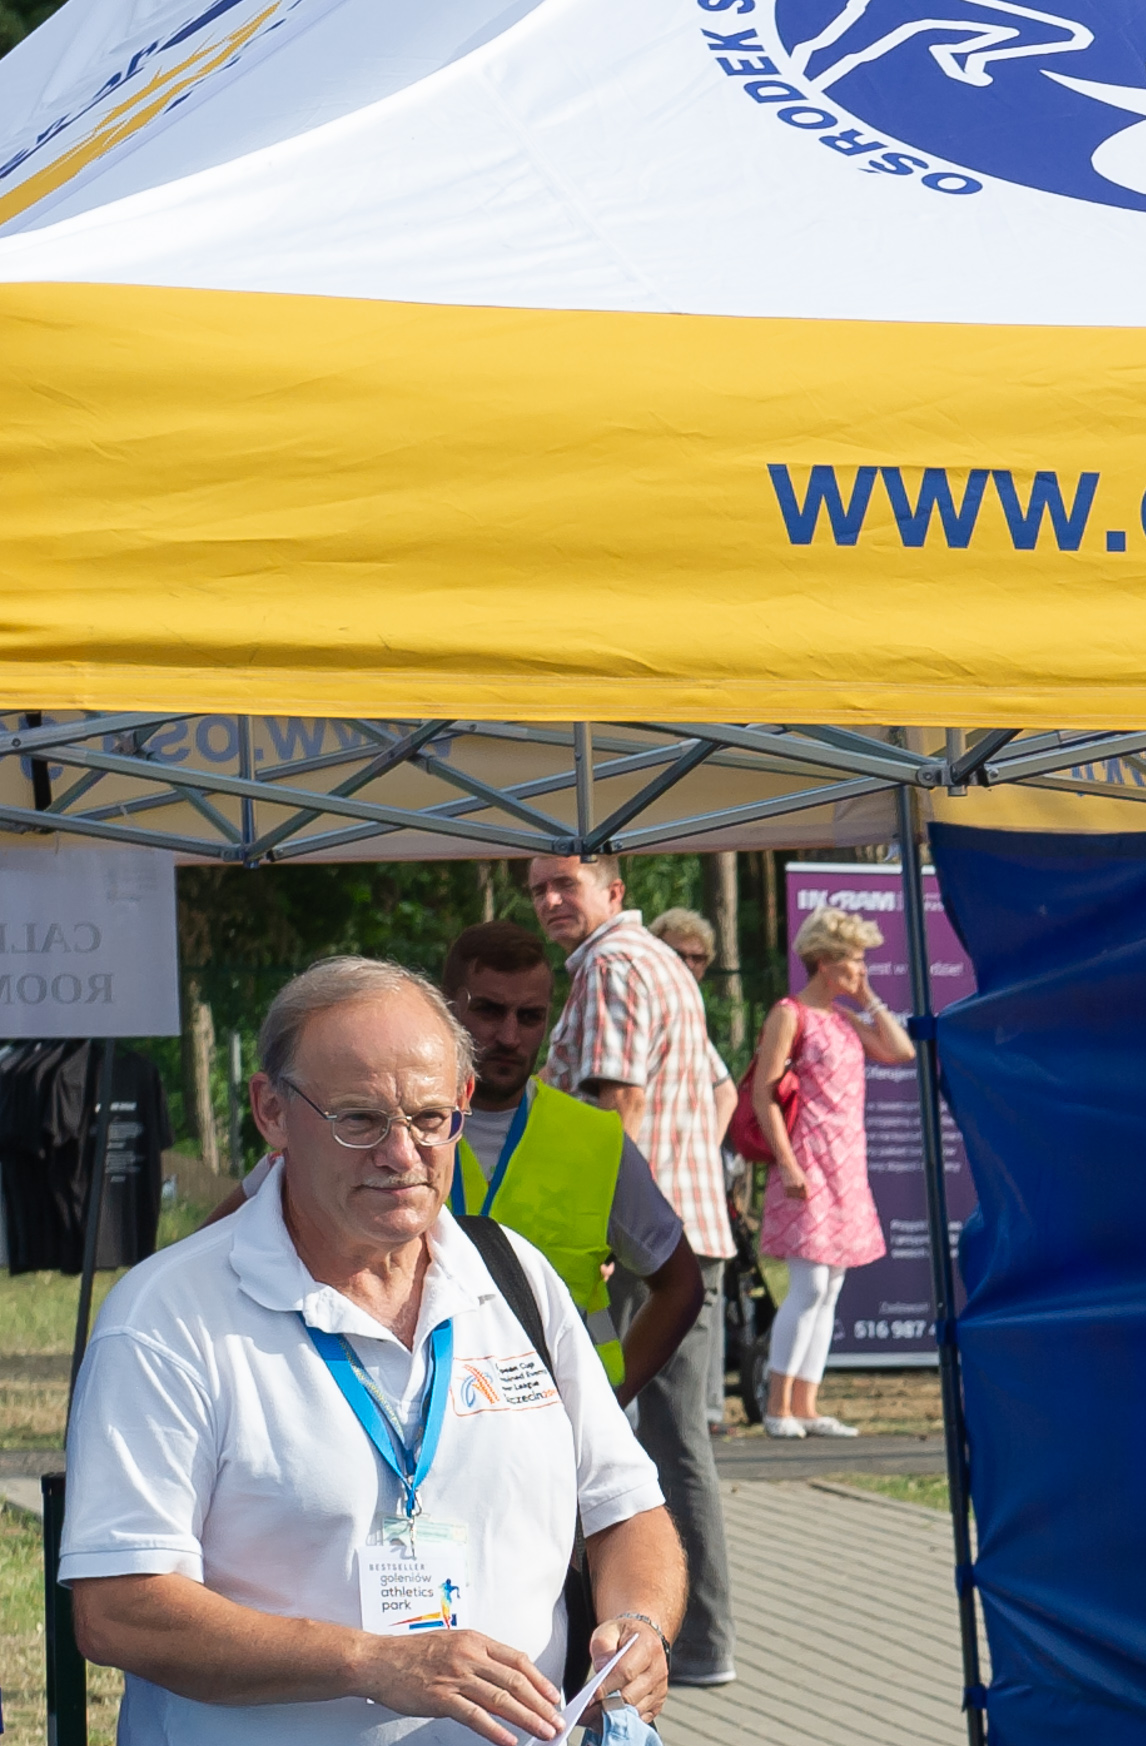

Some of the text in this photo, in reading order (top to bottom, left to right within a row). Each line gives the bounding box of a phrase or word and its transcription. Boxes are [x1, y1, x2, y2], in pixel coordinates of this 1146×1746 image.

[700, 28, 984, 195] OŚRODEK
[369, 1563, 425, 1572] BESTSELLER
[381, 1586, 434, 1598] athletics
[382, 1599, 412, 1613] park
